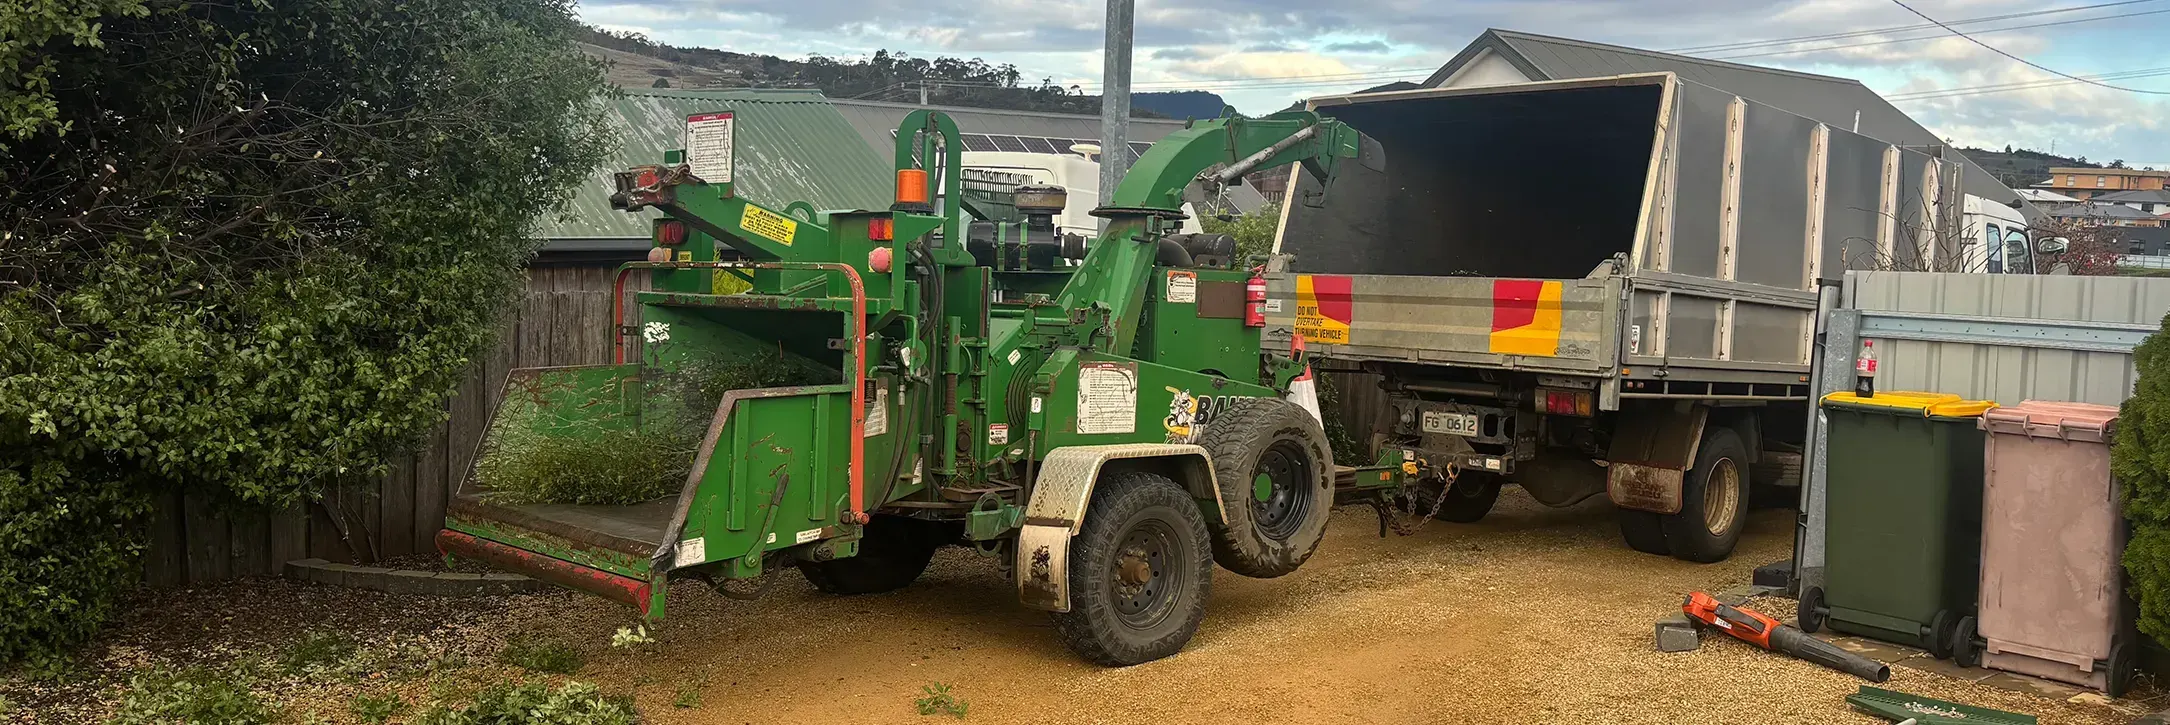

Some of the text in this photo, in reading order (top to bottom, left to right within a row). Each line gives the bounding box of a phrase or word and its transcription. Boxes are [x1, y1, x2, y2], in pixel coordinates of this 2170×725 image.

[758, 210, 784, 224] WARNING
[1297, 306, 1318, 316] DO NOT
[1296, 317, 1324, 327] OVERTAKE
[1295, 327, 1319, 338] TURNING
[1320, 329, 1342, 340] VEHICLE
[1425, 416, 1440, 429] FG
[1447, 418, 1476, 432] 0612
